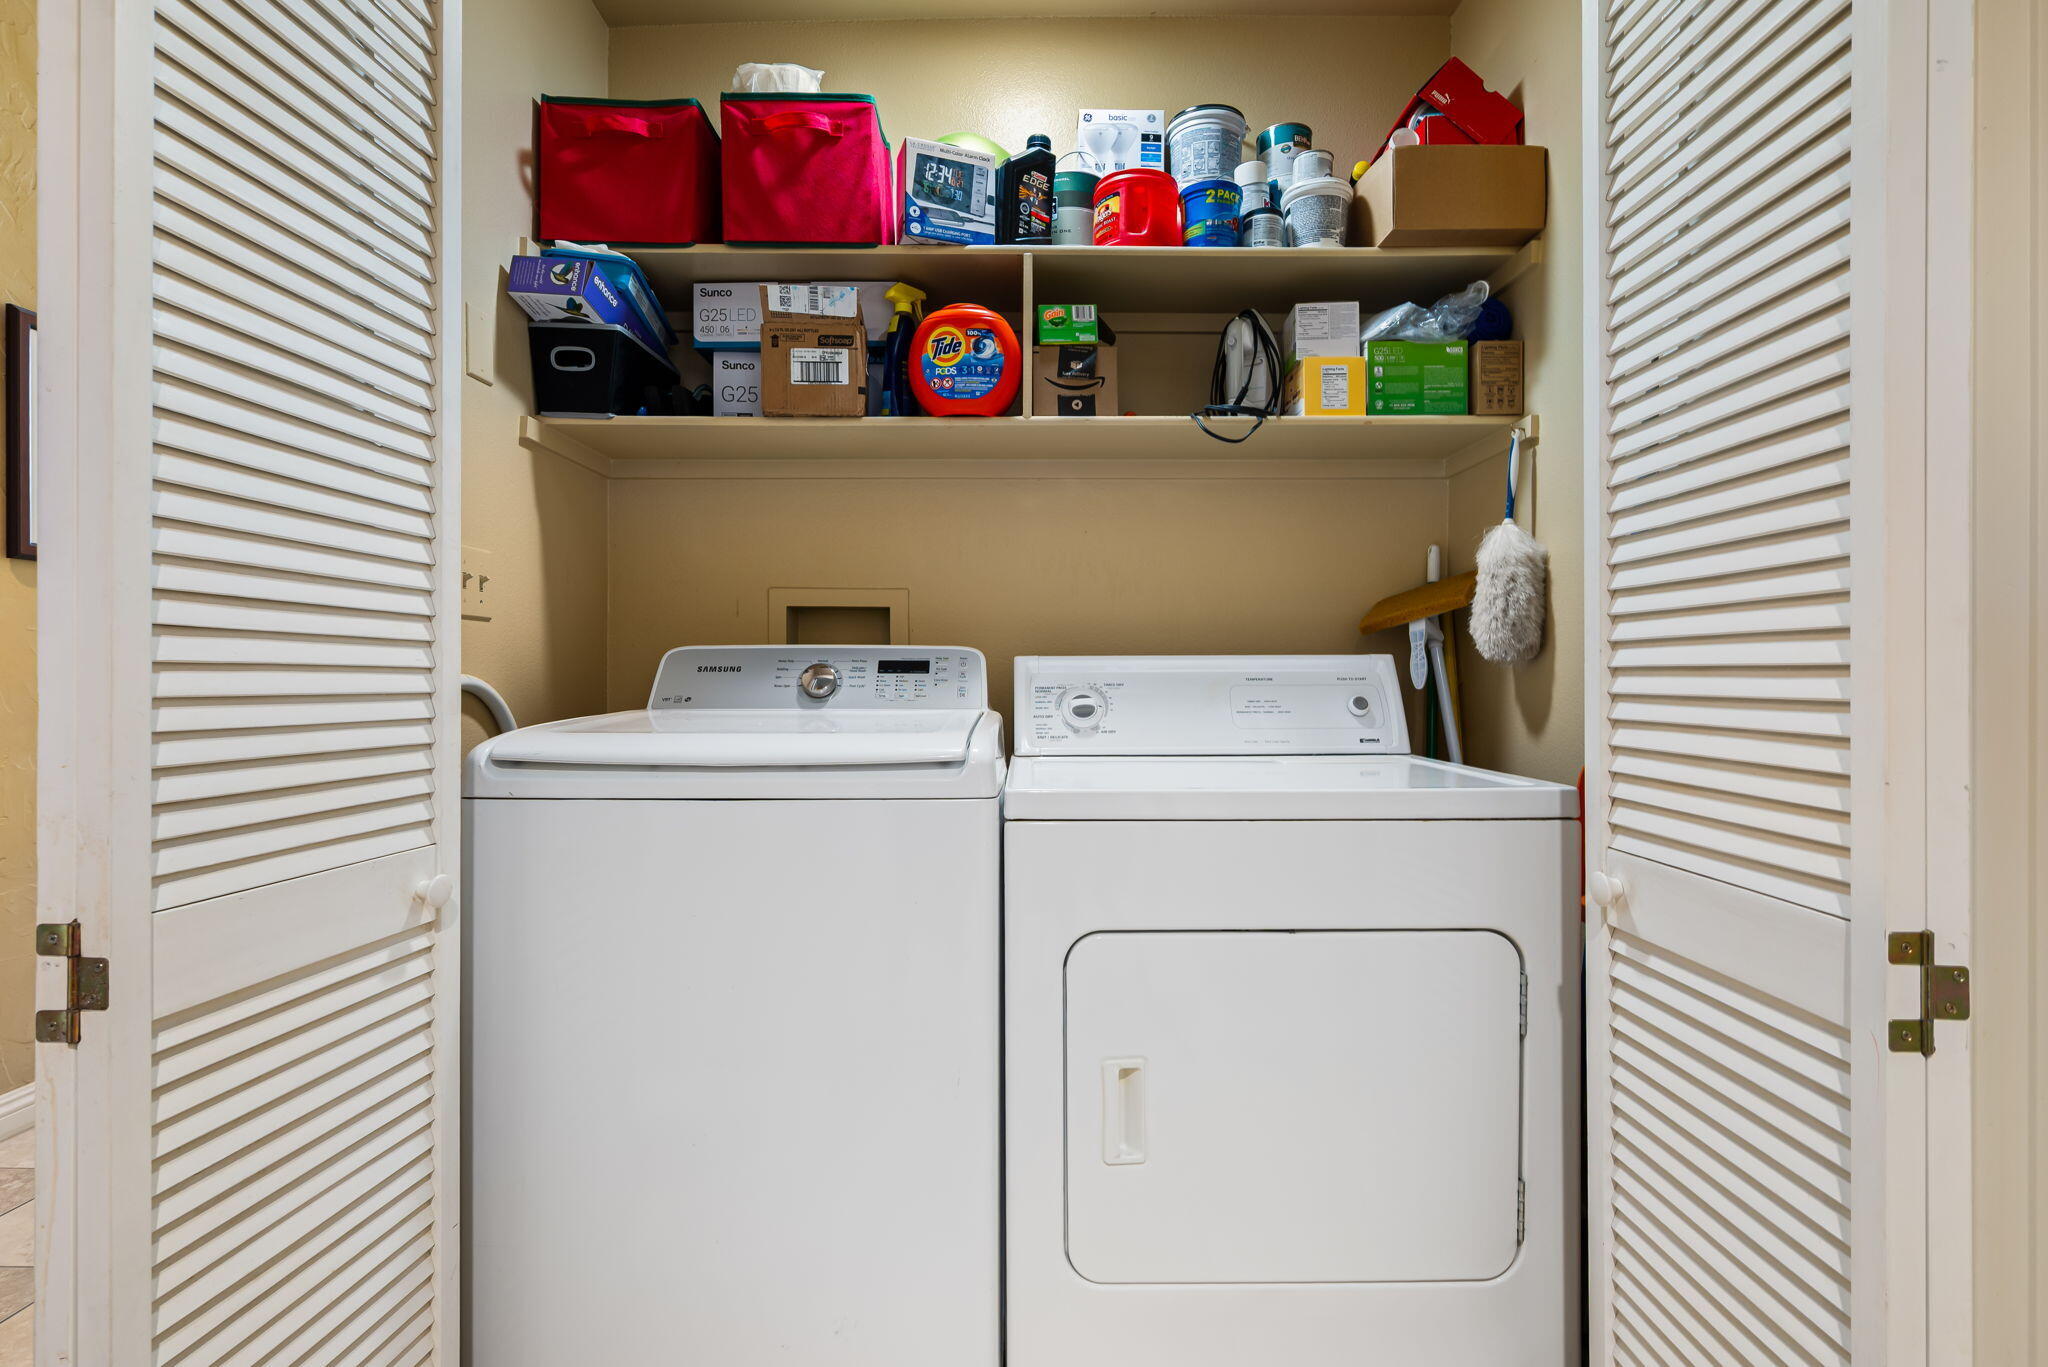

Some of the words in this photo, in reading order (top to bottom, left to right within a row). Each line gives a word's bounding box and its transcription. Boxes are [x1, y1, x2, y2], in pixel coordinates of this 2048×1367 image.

[1022, 174, 1050, 191] EDGE
[1206, 189, 1216, 203] 2
[1217, 189, 1240, 202] PACK
[570, 262, 581, 292] enhance
[593, 275, 618, 308] enhance
[700, 287, 733, 298] Sunco
[1043, 308, 1066, 321] Gain
[931, 335, 963, 361] Tide
[721, 360, 755, 371] Sunco
[935, 366, 957, 375] PODS
[721, 385, 759, 403] G25
[696, 665, 742, 673] SAMSUNG
